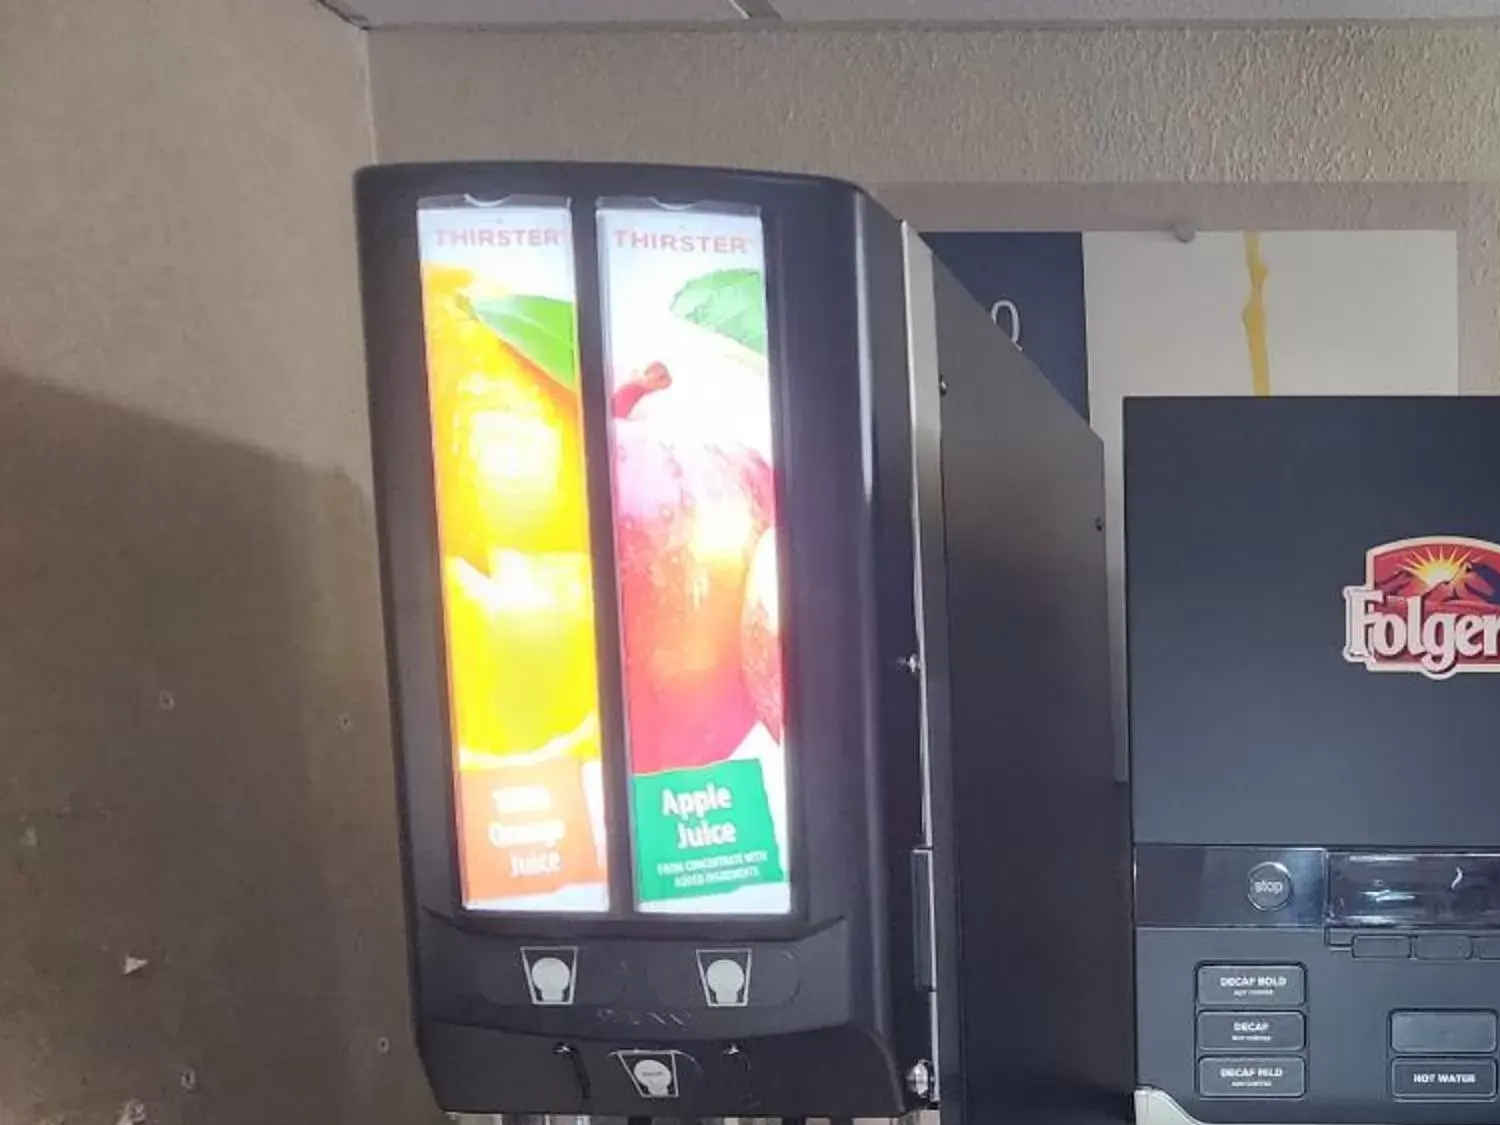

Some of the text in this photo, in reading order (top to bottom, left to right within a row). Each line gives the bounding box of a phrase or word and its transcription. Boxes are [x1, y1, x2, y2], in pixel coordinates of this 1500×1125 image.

[434, 228, 562, 248] THIRSTER
[612, 228, 748, 255] THIRSTER
[661, 780, 734, 821] Apple
[676, 819, 738, 849] Juice
[1253, 879, 1284, 895] stop
[1220, 975, 1256, 988] DECAF
[1233, 1021, 1270, 1032] DECAF
[1220, 1066, 1255, 1078] DECAF
[1412, 1072, 1477, 1085] HOT WATER
